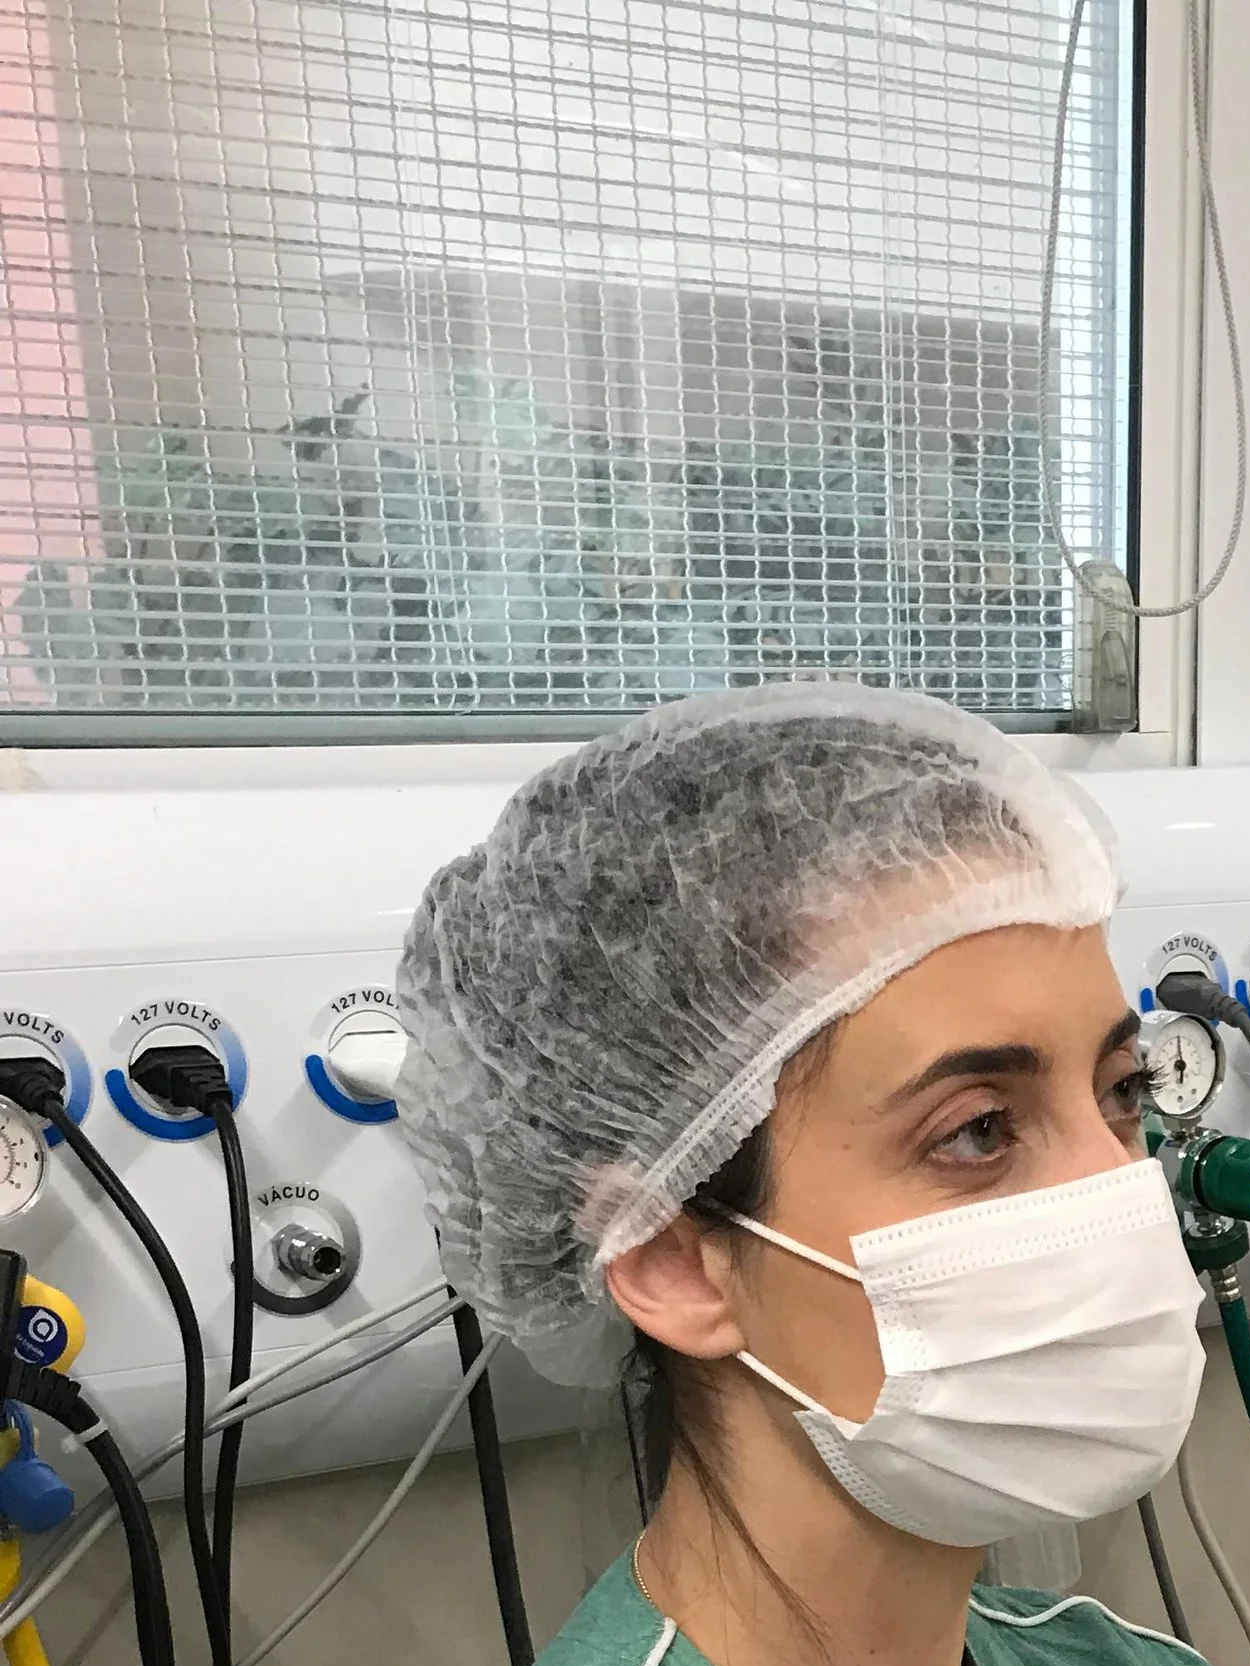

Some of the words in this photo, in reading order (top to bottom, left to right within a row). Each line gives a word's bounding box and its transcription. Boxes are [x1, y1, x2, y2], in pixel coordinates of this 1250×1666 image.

[1162, 938, 1181, 954] 127
[1183, 936, 1218, 962] VOLTS
[331, 993, 357, 1013] 127
[362, 990, 400, 1011] VOL
[4, 1011, 65, 1044] VOLTS
[131, 1004, 158, 1026] 127
[164, 1001, 222, 1031] VOLTS
[258, 1186, 320, 1206] VÁCUO
